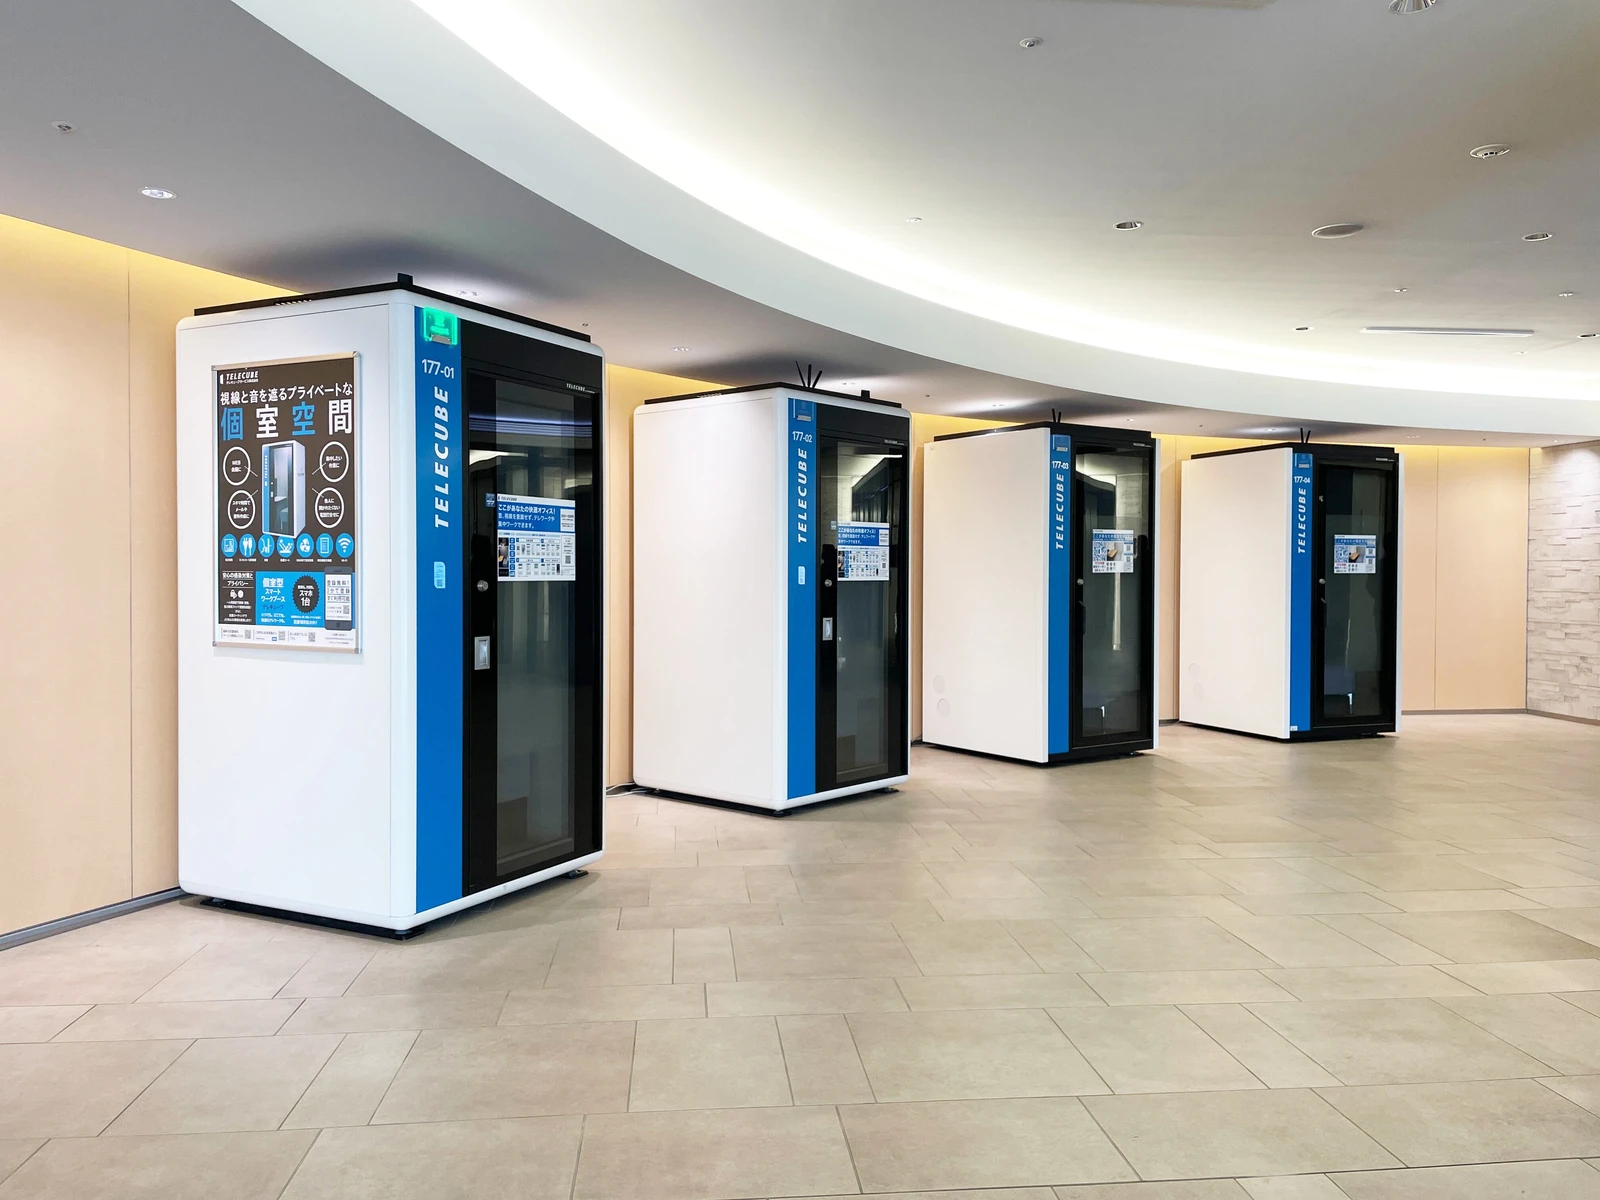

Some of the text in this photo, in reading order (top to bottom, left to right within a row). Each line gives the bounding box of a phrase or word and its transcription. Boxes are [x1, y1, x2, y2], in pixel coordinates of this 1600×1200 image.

[226, 370, 259, 380] TELECUBE
[422, 358, 455, 379] 177-01
[220, 382, 353, 405] 視線と音を遮るプライベートな
[221, 398, 352, 441] 個室空間
[792, 431, 813, 443] 177-02
[434, 386, 449, 528] TELECUBE
[1052, 461, 1069, 470] 177-03
[1294, 476, 1311, 484] 177-04
[798, 448, 808, 543] TELECUBE
[1056, 473, 1064, 550] TELECUBE
[1298, 488, 1306, 553] TELECUBE
[262, 577, 284, 588] 個室型
